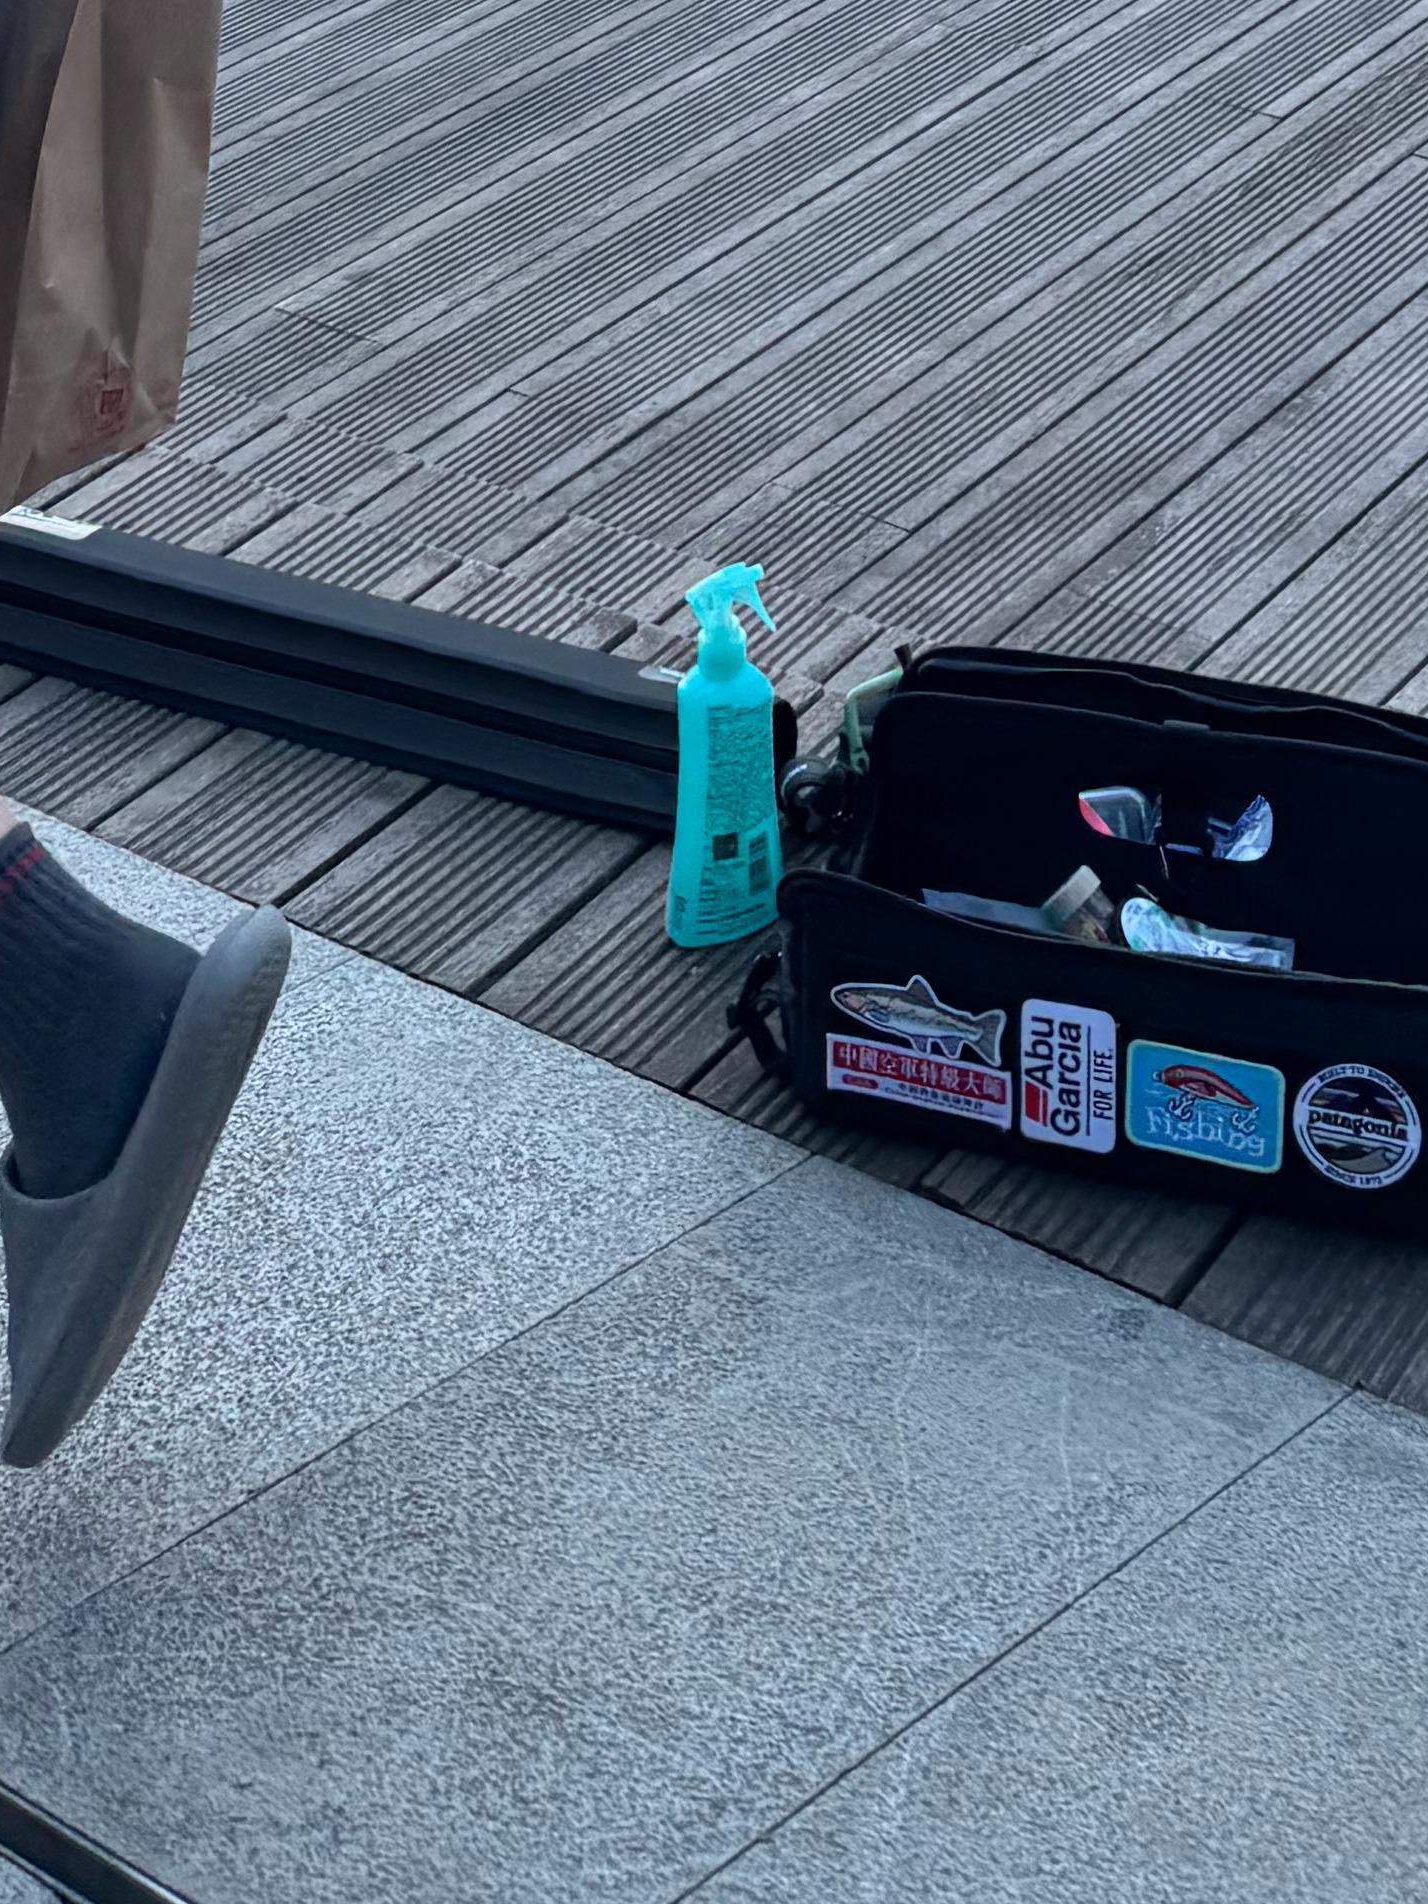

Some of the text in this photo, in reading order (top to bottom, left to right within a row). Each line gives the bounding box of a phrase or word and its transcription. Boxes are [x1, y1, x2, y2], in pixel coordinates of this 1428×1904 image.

[1024, 1016, 1054, 1090] Abu
[1050, 1021, 1082, 1136] Garcia
[1093, 1089, 1114, 1120] FOR
[1308, 1110, 1408, 1141] patagonia
